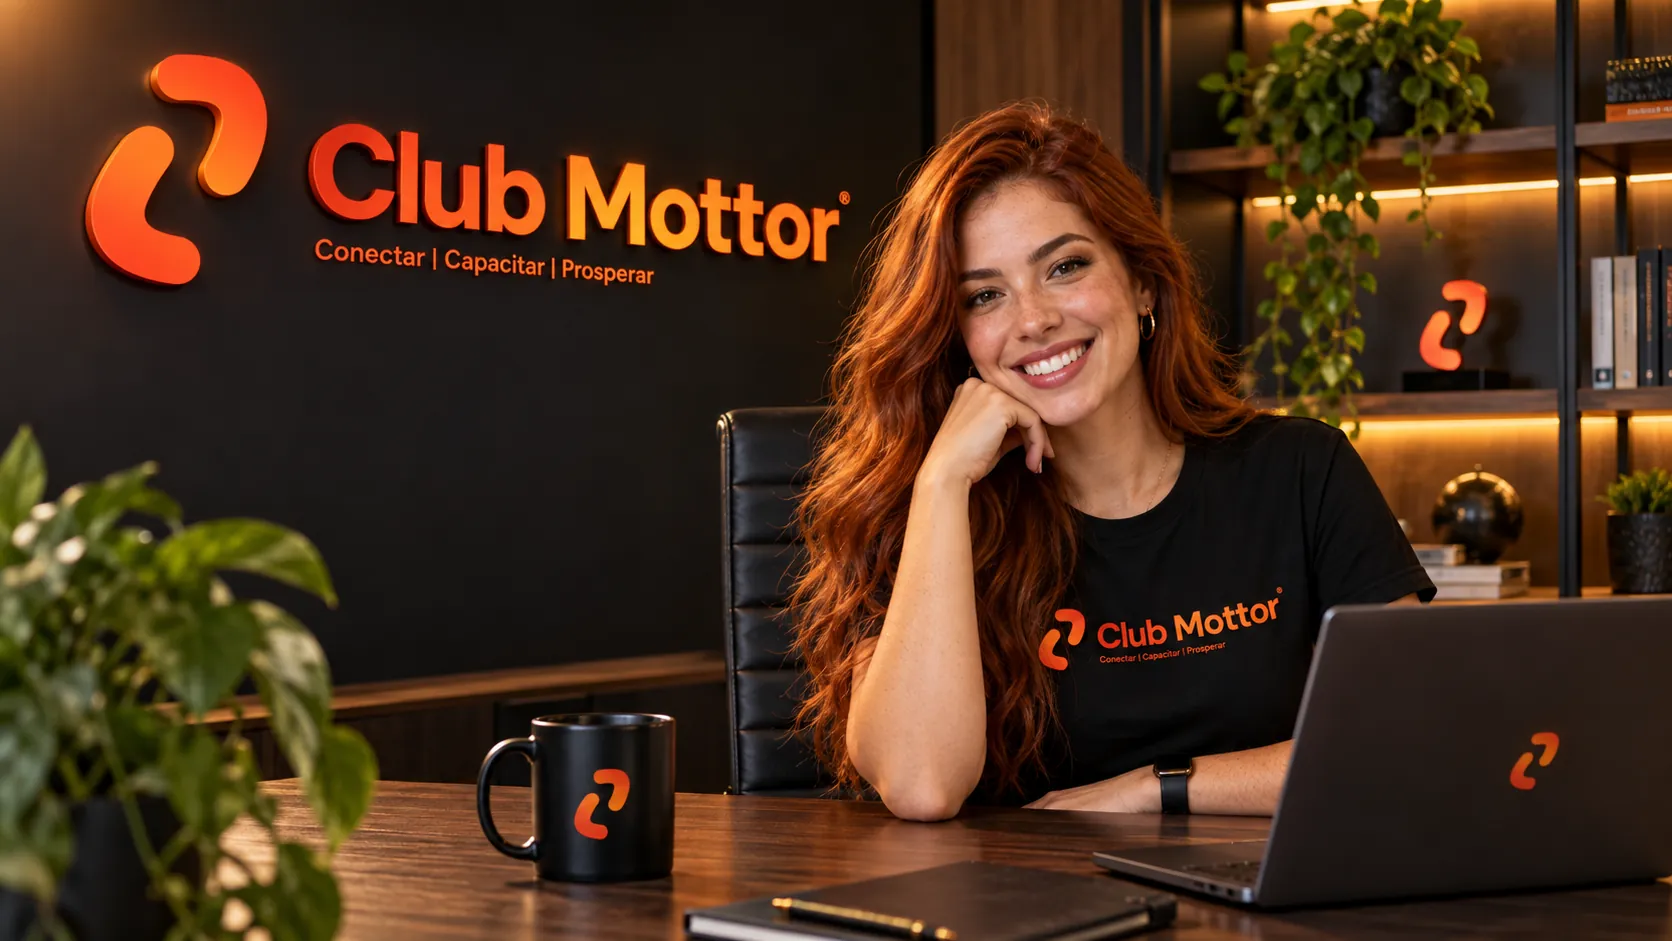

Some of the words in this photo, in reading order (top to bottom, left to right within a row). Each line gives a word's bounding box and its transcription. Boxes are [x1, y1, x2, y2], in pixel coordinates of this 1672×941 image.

[308, 123, 547, 236] Club
[314, 238, 426, 268] Conectar
[444, 248, 546, 277] Capacitar
[561, 258, 655, 287] Prosperar
[1097, 619, 1168, 649] Club
[1099, 655, 1137, 663] Conectar
[1142, 649, 1181, 661] Capacitar
[1186, 641, 1226, 654] Prosperar
